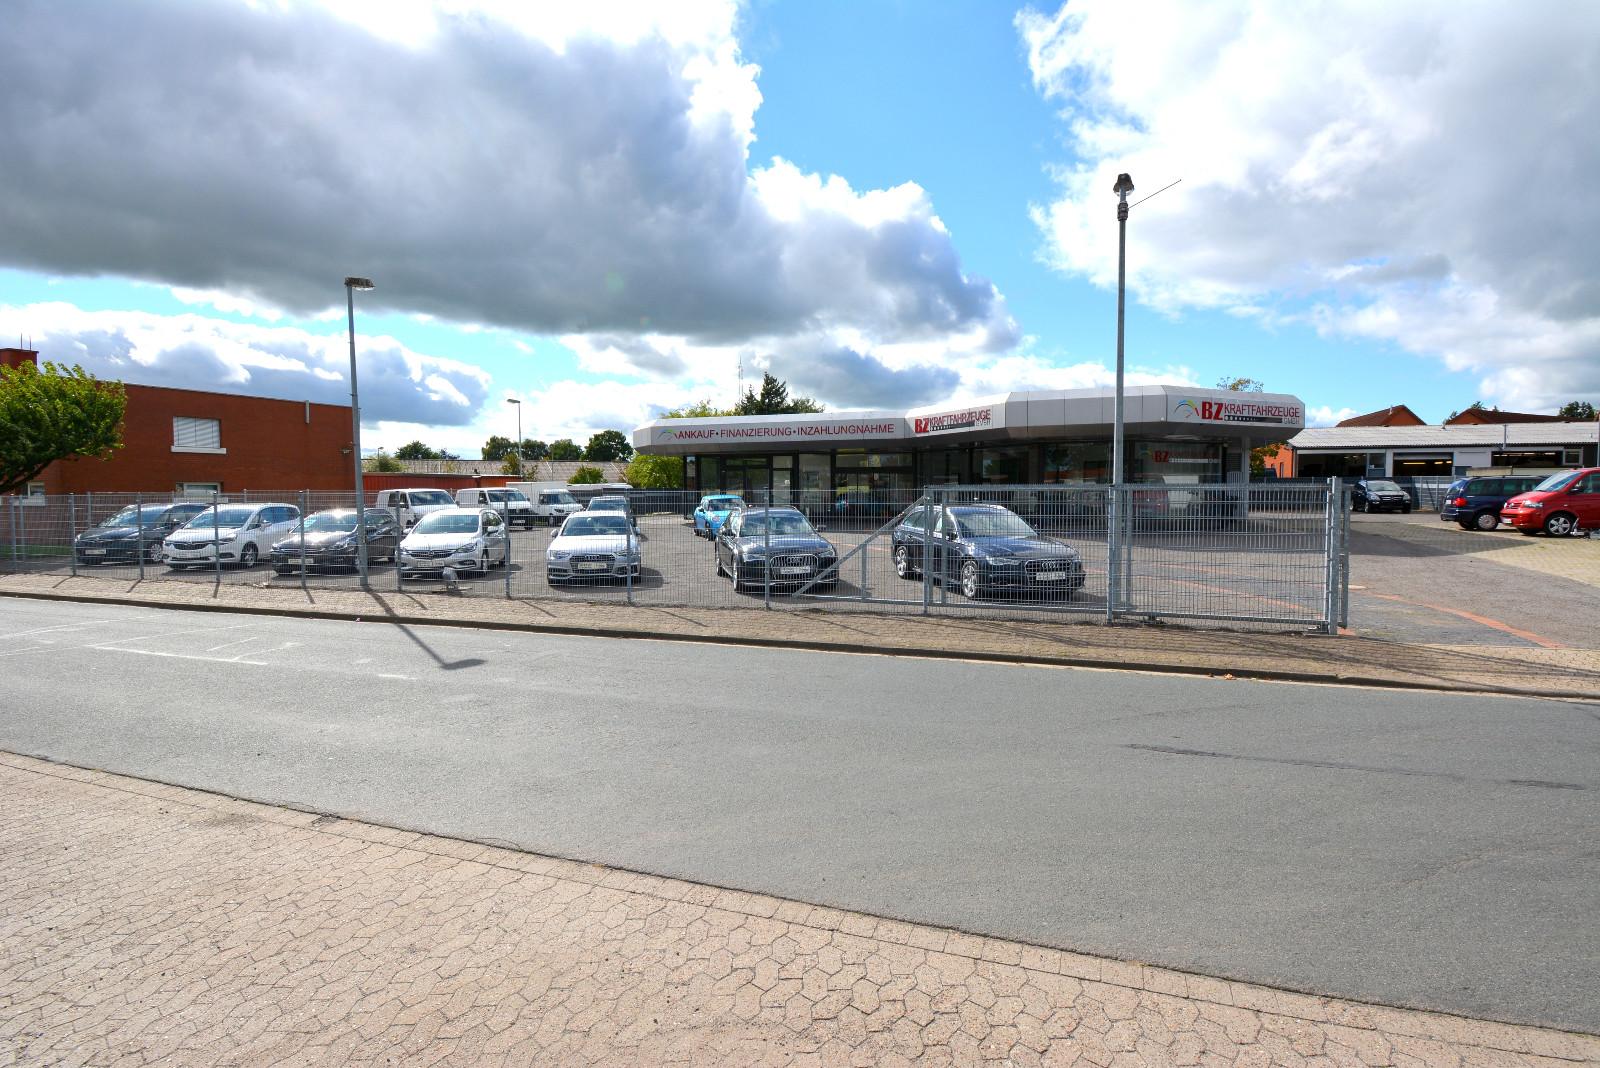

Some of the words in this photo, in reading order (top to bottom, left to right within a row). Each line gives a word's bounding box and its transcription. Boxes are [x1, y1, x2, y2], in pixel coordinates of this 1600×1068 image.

[1201, 401, 1223, 420] BZ
[1224, 403, 1300, 418] KRAFTFAHRZEUGE
[914, 417, 930, 433] BZ
[929, 409, 991, 427] KRAFTFAHRZEUGE
[678, 429, 715, 439] ANKAUF
[720, 426, 792, 438] FINANZIERUNG
[797, 423, 895, 436] INZAHLUNGNAHME
